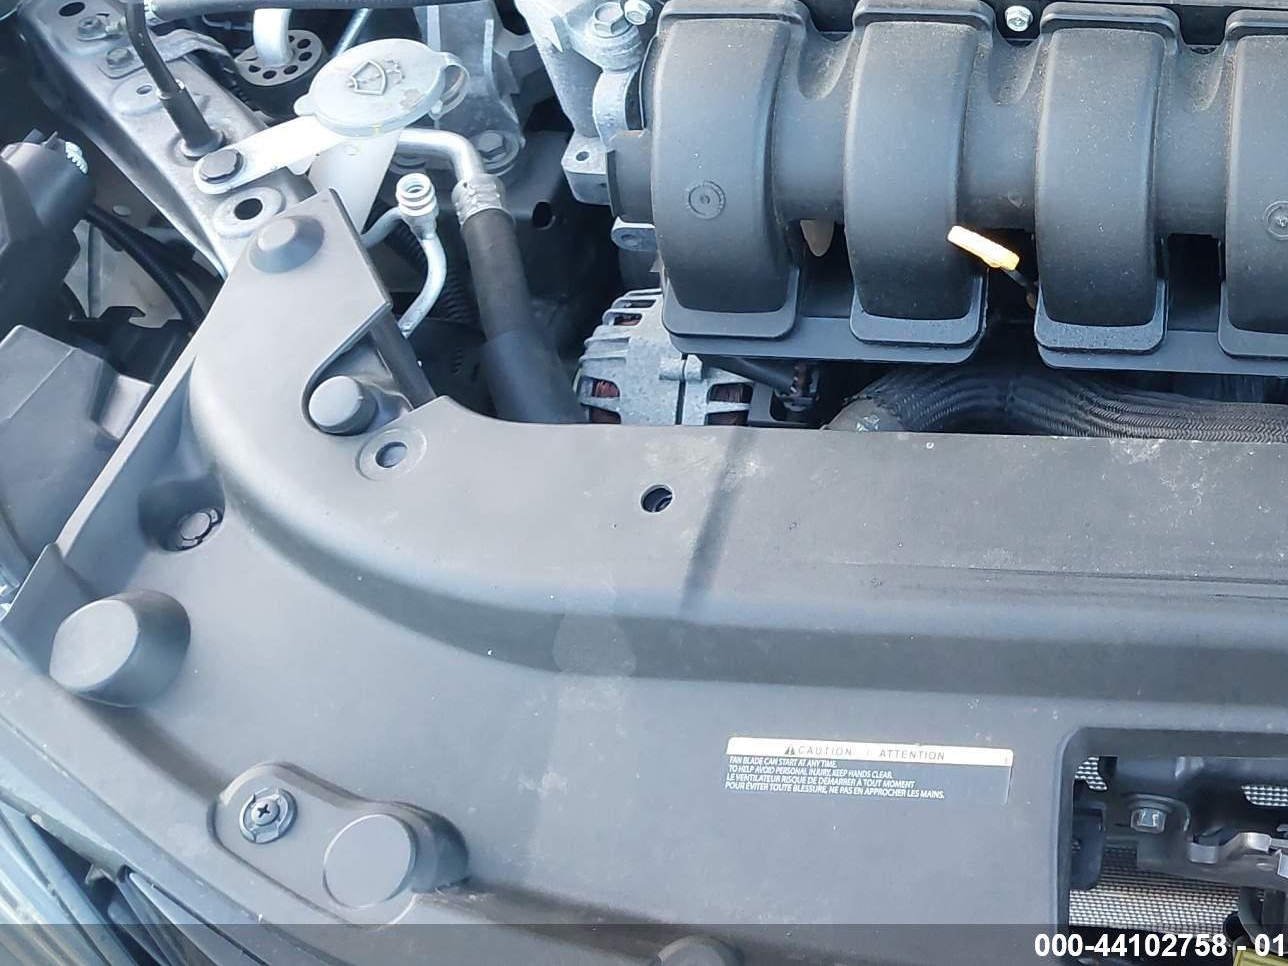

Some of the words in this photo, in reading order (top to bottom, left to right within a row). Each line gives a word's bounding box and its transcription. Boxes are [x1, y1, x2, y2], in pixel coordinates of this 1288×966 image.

[730, 755, 742, 764] FAN
[743, 756, 764, 765] BLADE
[764, 757, 778, 765] CAN
[779, 758, 798, 766] START
[807, 759, 820, 767] ANY
[798, 745, 851, 755] CAUTION
[880, 749, 945, 761] ATTENTION
[729, 764, 738, 773] TO
[738, 765, 754, 773] HELP
[755, 766, 776, 774] AVOID
[776, 767, 807, 776] PERSONAL
[832, 769, 848, 777] KEEP
[848, 770, 871, 778] HANDS
[727, 772, 736, 781] LE
[736, 773, 781, 783] VENTILATEUR
[781, 775, 807, 784] RISQUE
[807, 776, 818, 785] DE
[863, 778, 882, 787] TOUT
[883, 779, 915, 788] MOMENT
[725, 781, 745, 790] POUR
[769, 783, 792, 792] TOUTE
[829, 786, 839, 794] NE
[840, 786, 853, 794] PAS
[853, 787, 864, 795] EN
[864, 787, 906, 797] APPROCHER
[907, 789, 919, 797] LES
